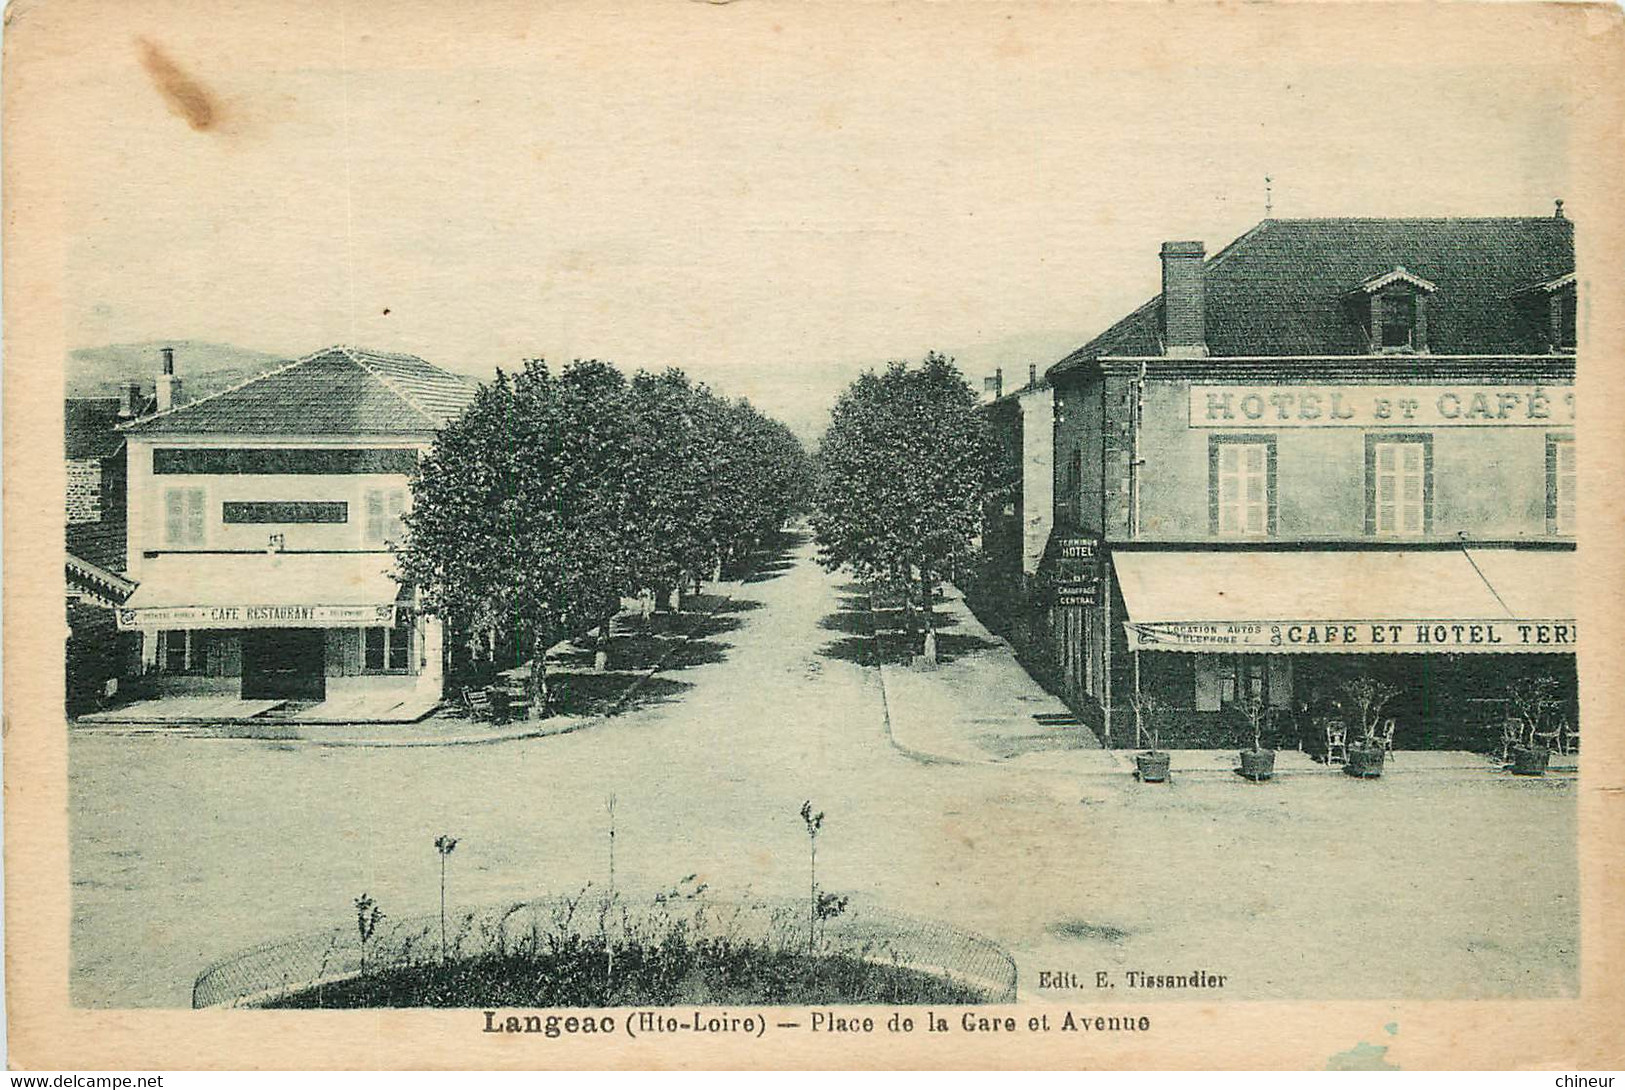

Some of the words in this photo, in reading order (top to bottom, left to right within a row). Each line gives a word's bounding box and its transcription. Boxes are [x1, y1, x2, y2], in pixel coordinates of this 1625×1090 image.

[1205, 392, 1355, 420] HOTEL
[1374, 397, 1418, 419] ET
[1436, 387, 1550, 420] CAFÉ
[1062, 546, 1094, 557] HOTEL
[211, 607, 240, 620] CAFE
[246, 606, 315, 620] RESTAURANT
[1166, 625, 1217, 634] LOCATION
[1227, 625, 1262, 634] AUTOS
[1288, 625, 1357, 644] CAFE
[1371, 625, 1403, 643] ET
[1416, 624, 1502, 644] HOTEL
[1176, 635, 1237, 643] TELEPHONE
